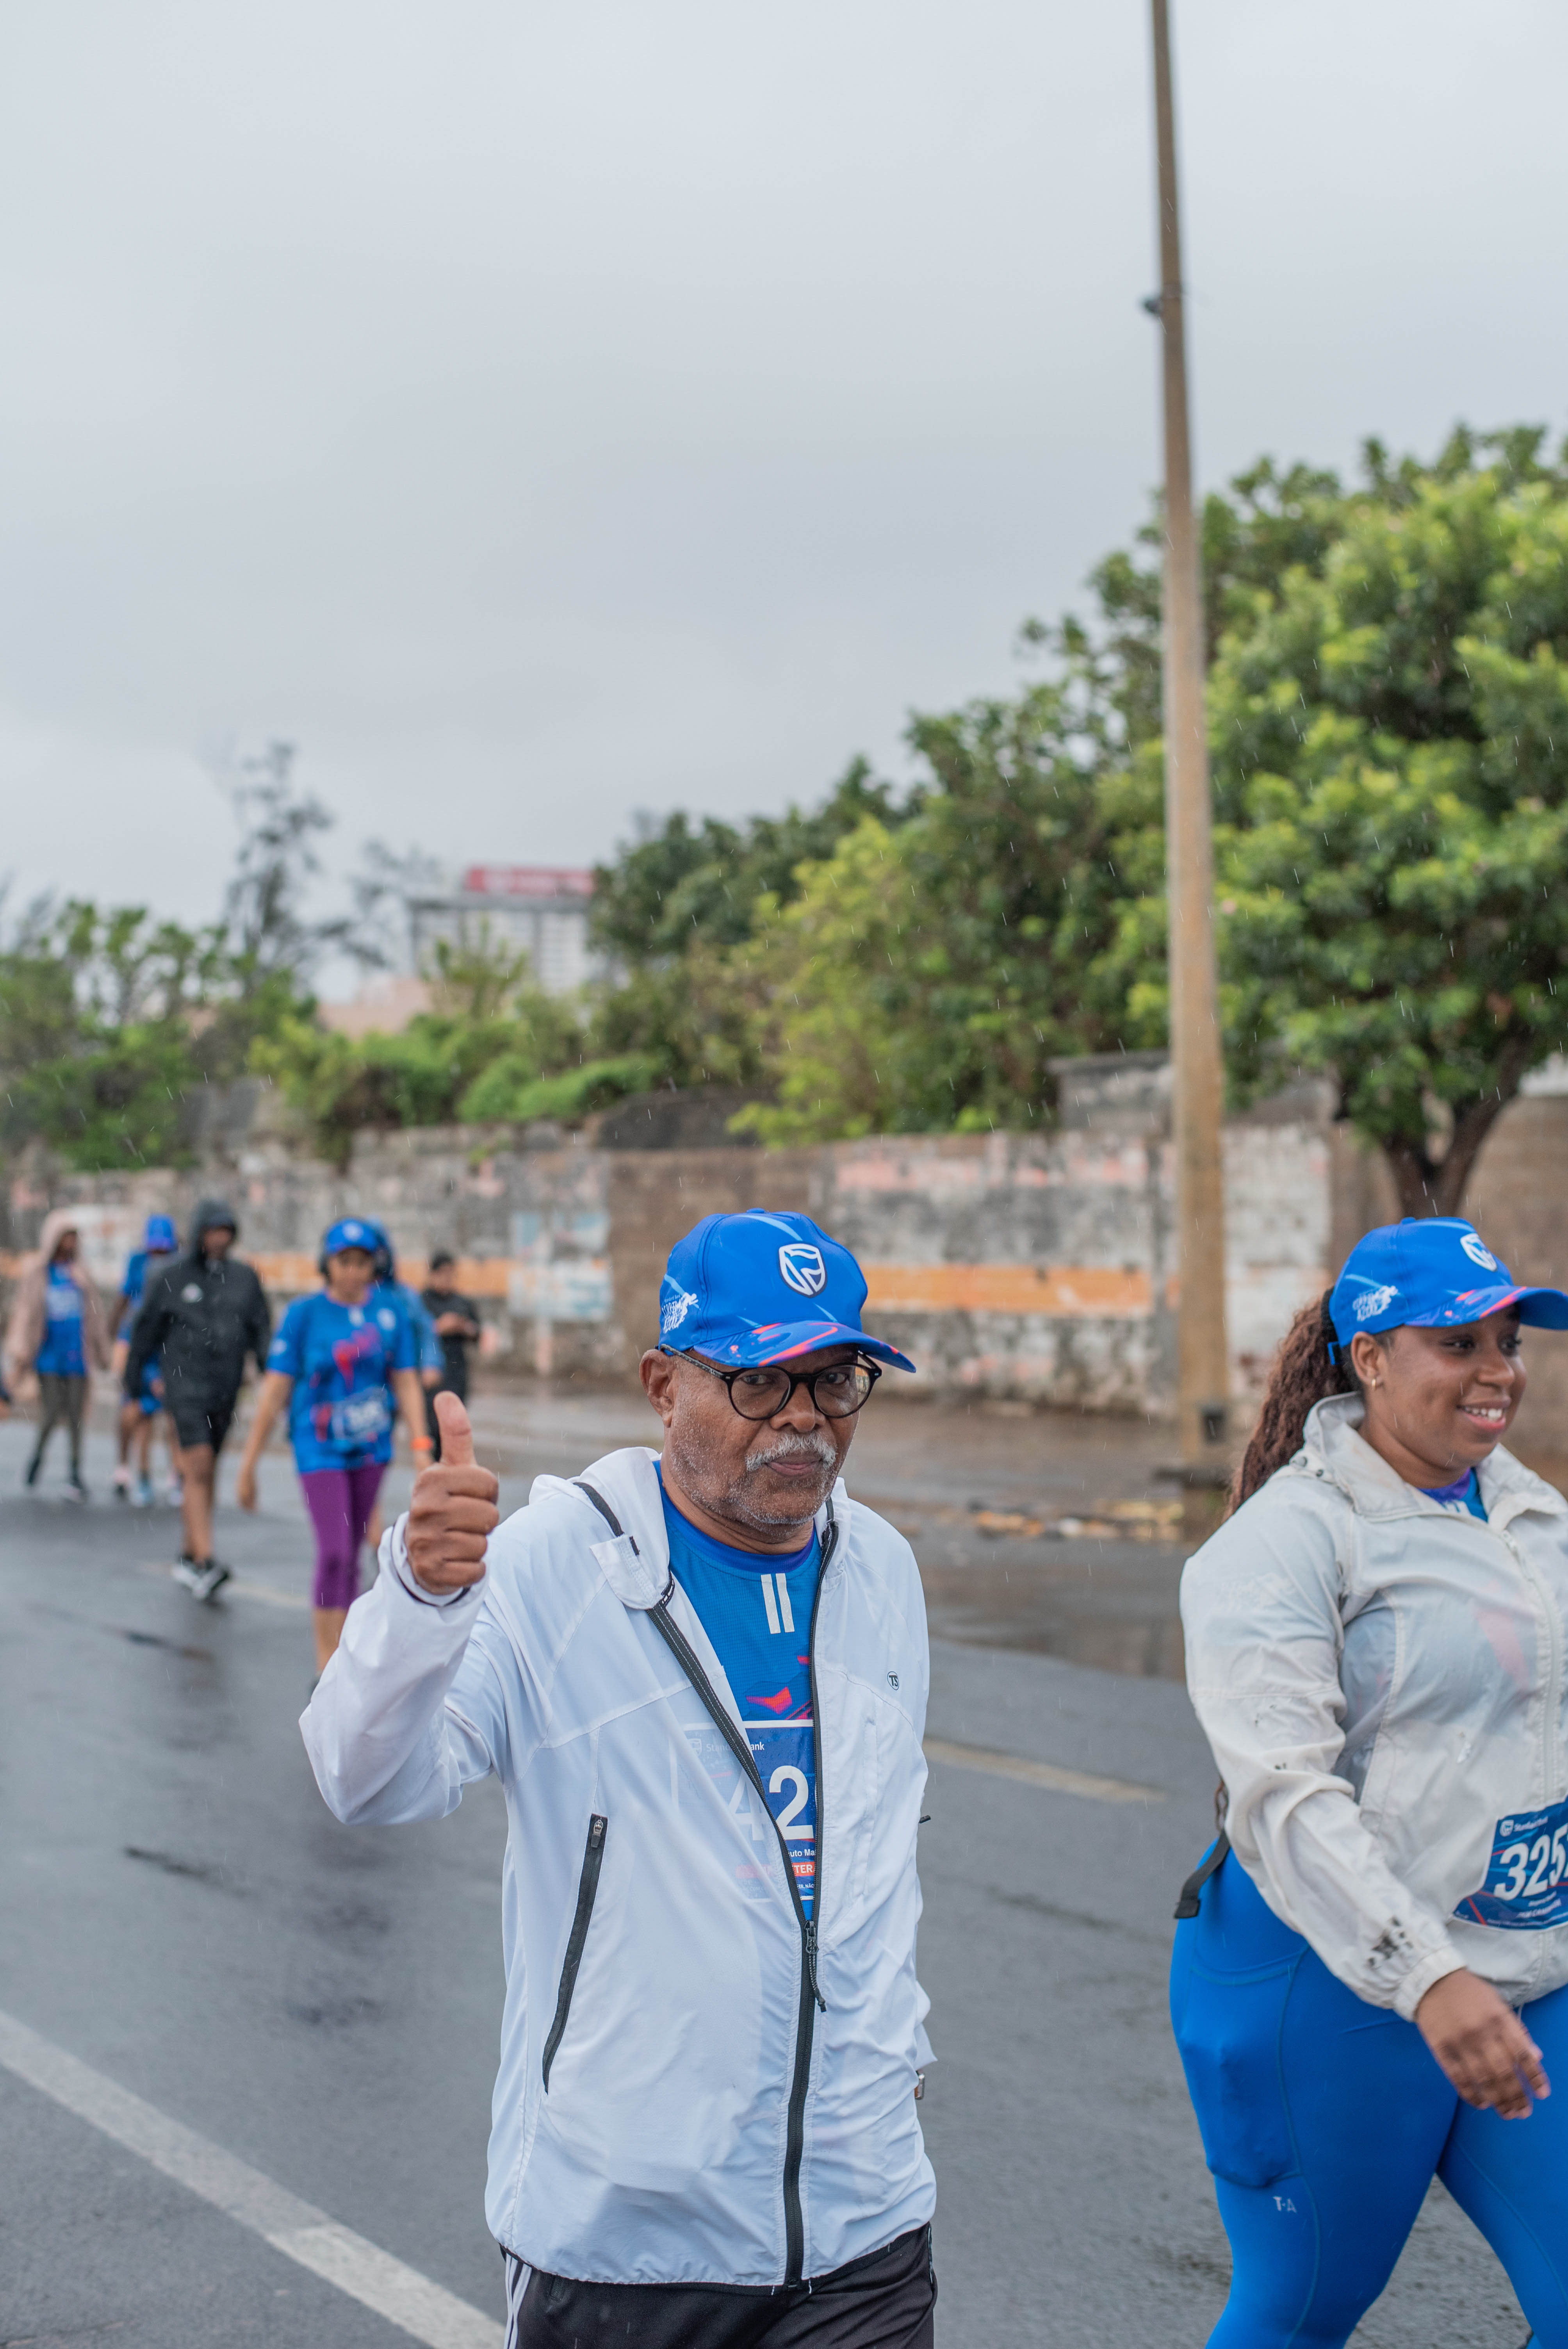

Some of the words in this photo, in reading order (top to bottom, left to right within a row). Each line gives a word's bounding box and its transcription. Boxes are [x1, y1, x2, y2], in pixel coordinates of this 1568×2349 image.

[889, 1675, 898, 1687] TS
[750, 1741, 765, 1751] ank
[1494, 1823, 1568, 1901] 325
[792, 1864, 815, 1874] TER
